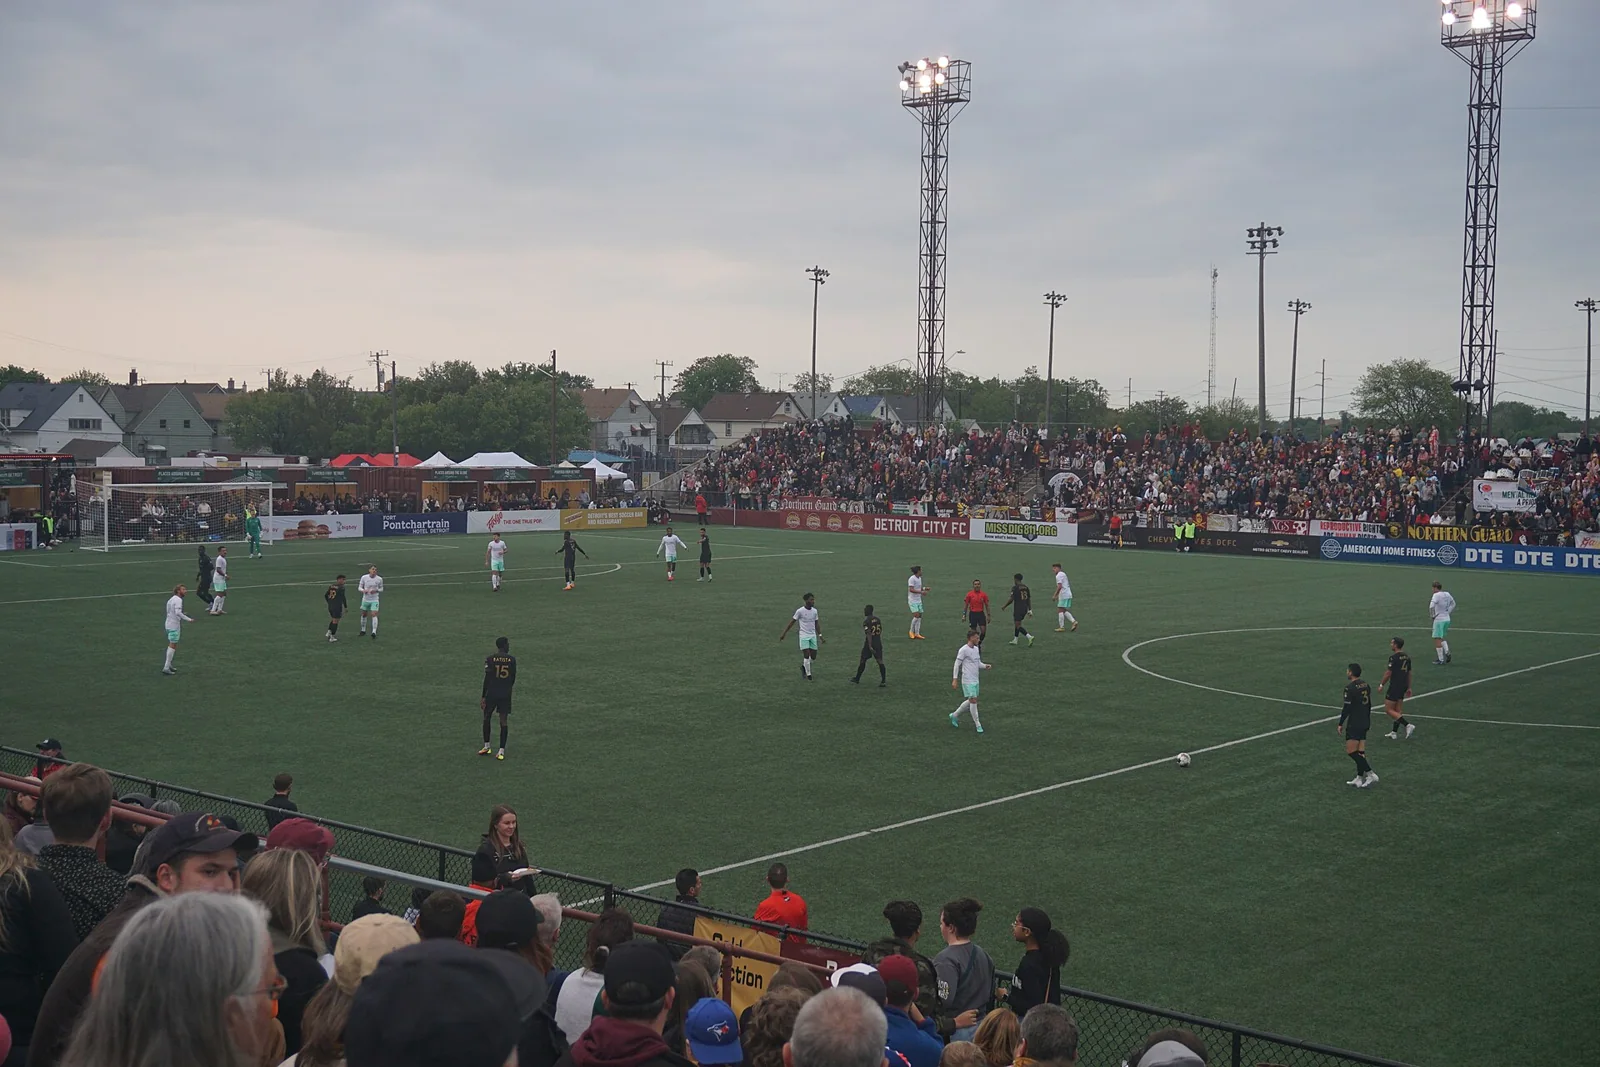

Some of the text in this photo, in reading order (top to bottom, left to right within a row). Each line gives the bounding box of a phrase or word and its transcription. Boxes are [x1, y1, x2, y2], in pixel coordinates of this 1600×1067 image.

[780, 498, 837, 511] Northern Guard
[383, 519, 449, 530] Pontchartrain
[874, 518, 919, 532] DETROIT
[922, 520, 947, 534] CITY
[951, 522, 966, 535] FC
[1320, 521, 1361, 531] REPRODUCTIVE
[1407, 525, 1513, 542] NORTHERN GUARD
[1343, 544, 1381, 554] AMERICAN
[1383, 546, 1404, 555] HOME
[1406, 547, 1436, 557] FITNESS
[1465, 548, 1503, 563] DTE
[1514, 550, 1553, 566] DTE
[1565, 553, 1600, 568] DTE
[871, 625, 880, 636] 25
[495, 665, 509, 679] 15
[1401, 660, 1408, 672] 4
[1361, 690, 1369, 704] 3
